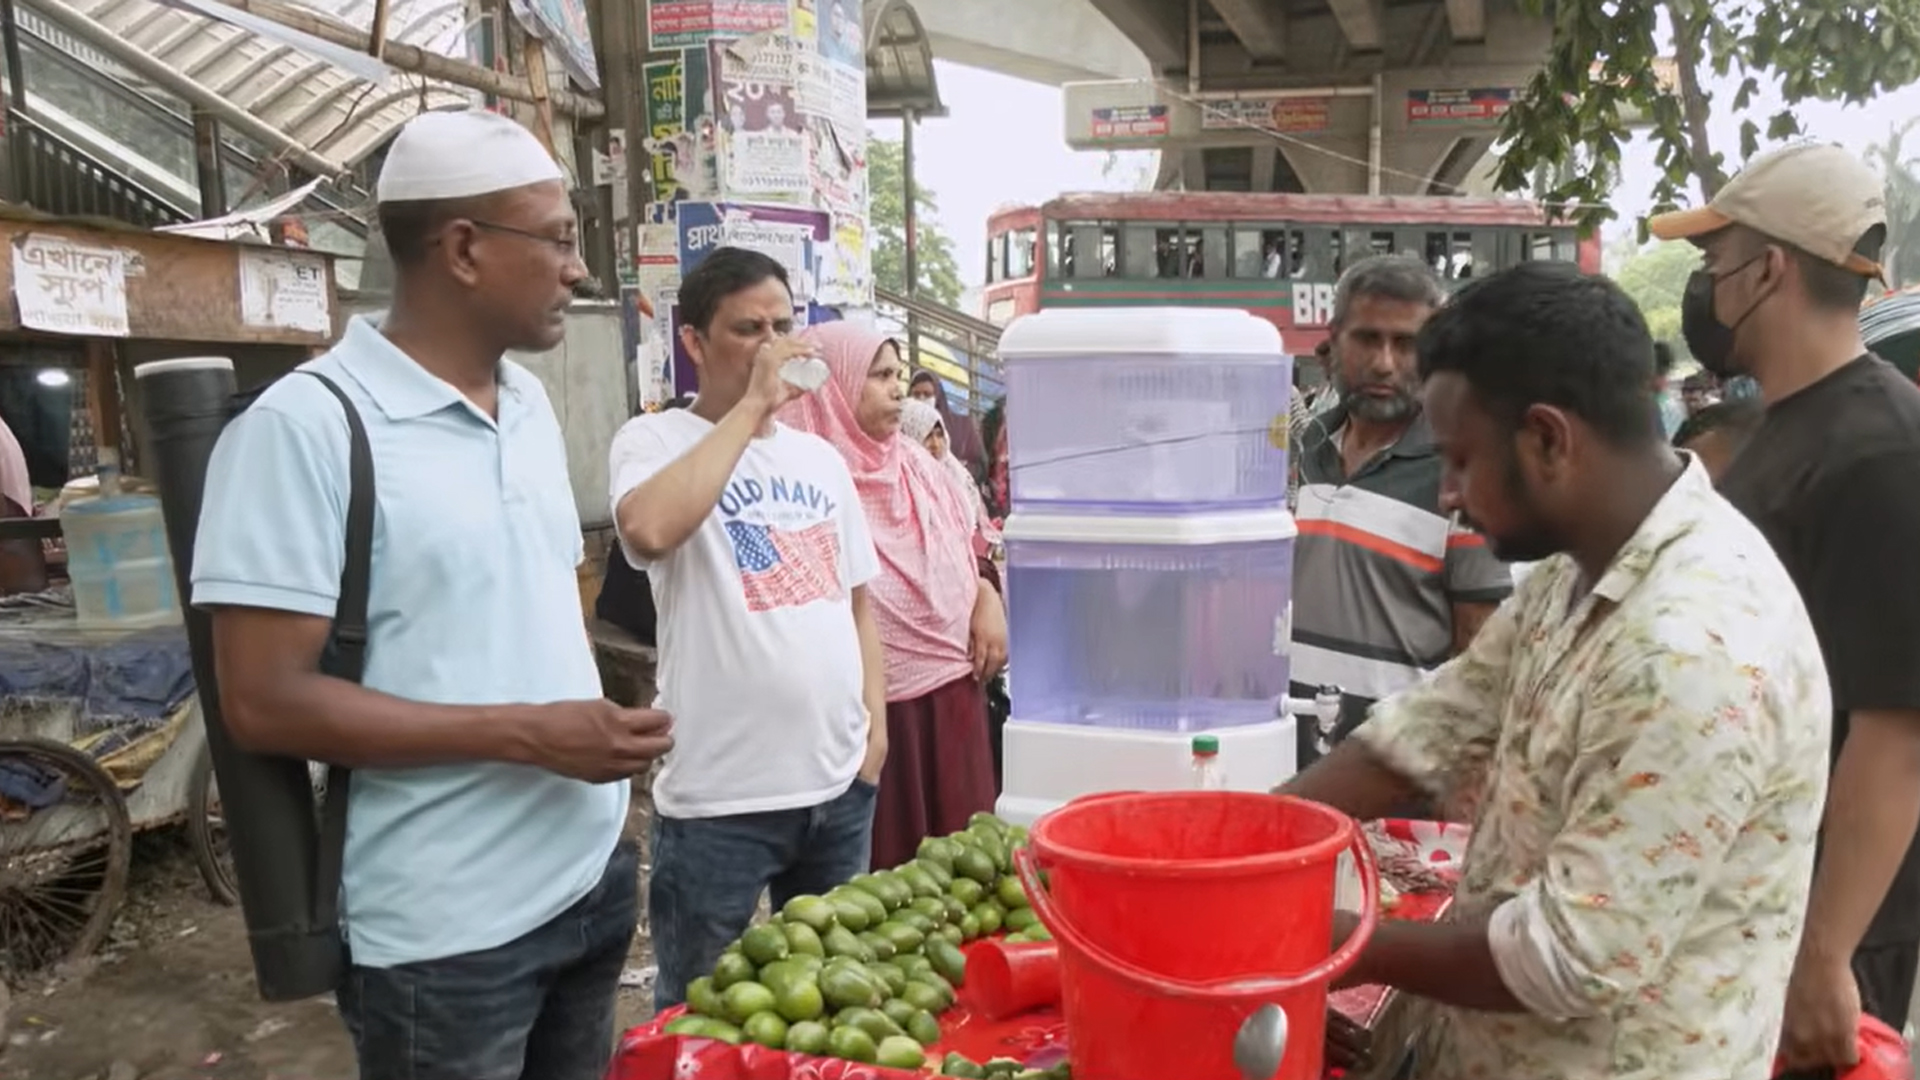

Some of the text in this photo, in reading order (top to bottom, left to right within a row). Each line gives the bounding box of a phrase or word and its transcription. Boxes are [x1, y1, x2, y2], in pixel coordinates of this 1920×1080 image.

[22, 247, 112, 275] এখানে
[36, 273, 107, 309] স্যুপ
[1292, 283, 1334, 324] BR
[718, 475, 836, 518] OLD NAVY
